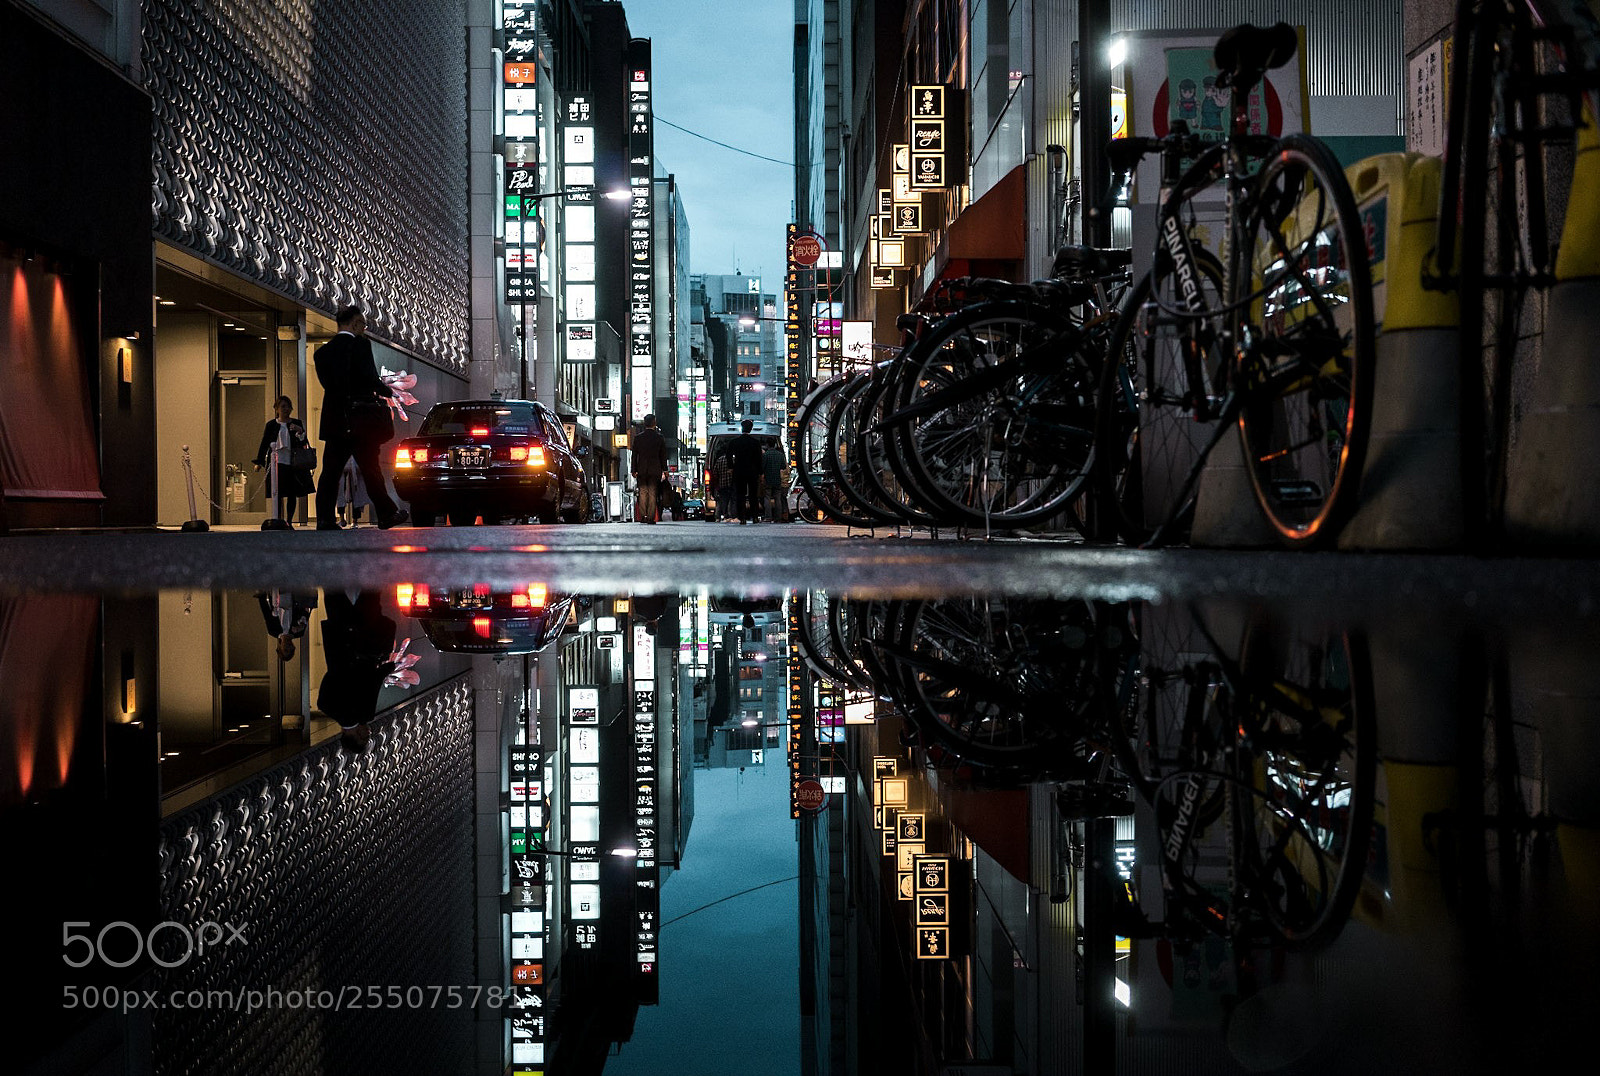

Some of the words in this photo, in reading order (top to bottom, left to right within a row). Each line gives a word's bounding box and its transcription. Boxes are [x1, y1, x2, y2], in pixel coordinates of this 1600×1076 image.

[795, 244, 819, 256] 消火栓
[460, 456, 484, 466] 80-07
